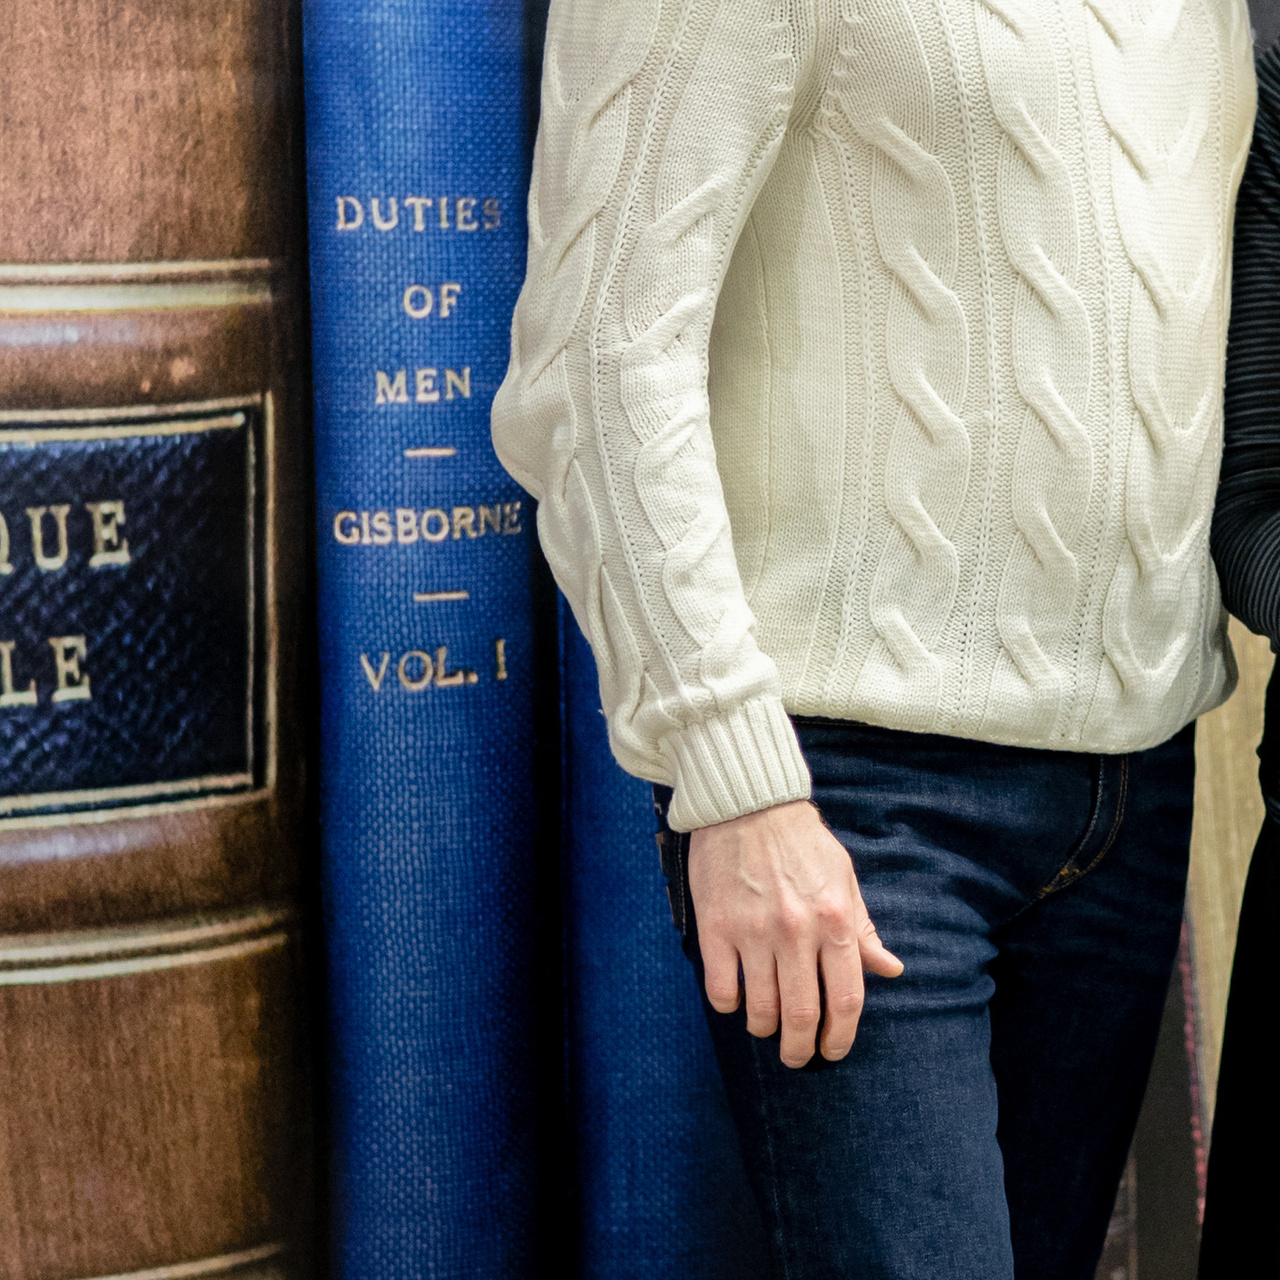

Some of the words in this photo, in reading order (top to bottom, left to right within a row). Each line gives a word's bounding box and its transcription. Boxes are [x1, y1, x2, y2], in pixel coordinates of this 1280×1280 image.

[335, 196, 502, 231] DUTIES
[403, 283, 461, 320] OF
[375, 366, 471, 404] MEN
[333, 501, 521, 545] GISBORNE
[360, 647, 478, 691] VOL.
